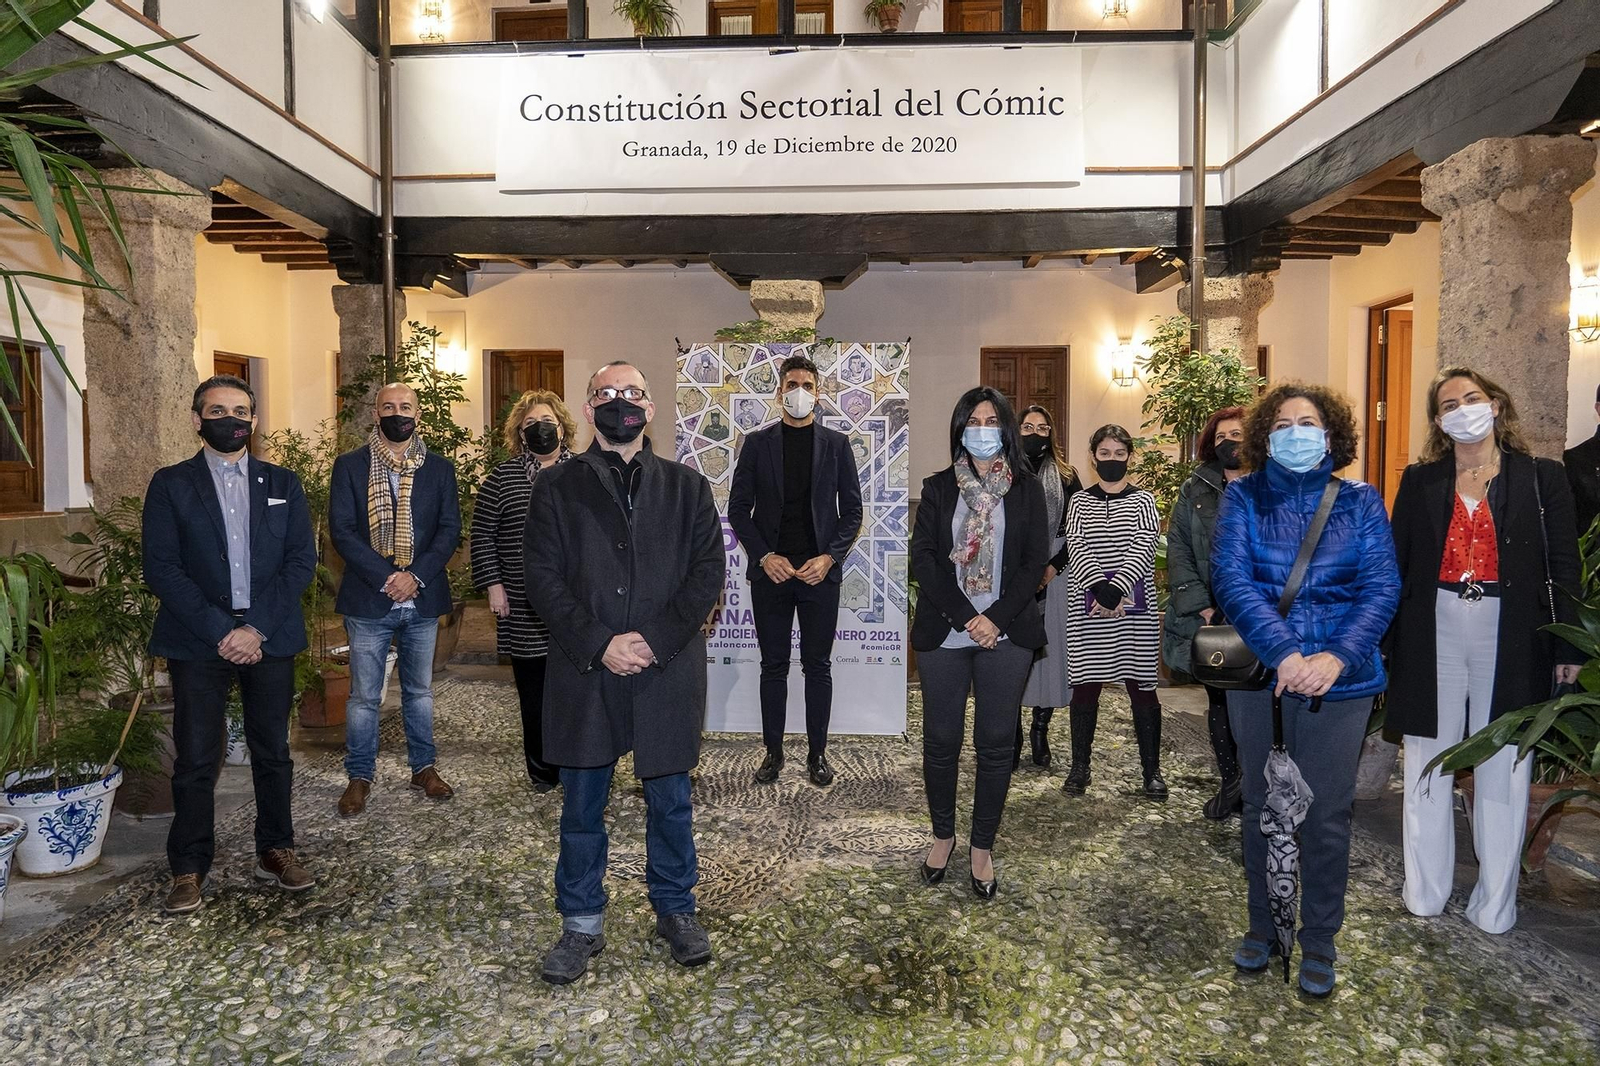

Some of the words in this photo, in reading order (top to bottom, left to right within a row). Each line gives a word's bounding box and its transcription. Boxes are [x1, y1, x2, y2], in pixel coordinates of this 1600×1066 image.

[520, 92, 728, 123] Constitución
[740, 88, 883, 120] Sectorial
[894, 88, 944, 117] del
[956, 86, 1065, 117] Cómic
[622, 140, 708, 160] Granada,
[716, 140, 738, 156] 19
[744, 138, 767, 155] de
[773, 134, 875, 155] Diciembre
[881, 135, 904, 153] de
[911, 136, 957, 153] 2020
[834, 630, 867, 641] NERO
[869, 630, 901, 642] 2021
